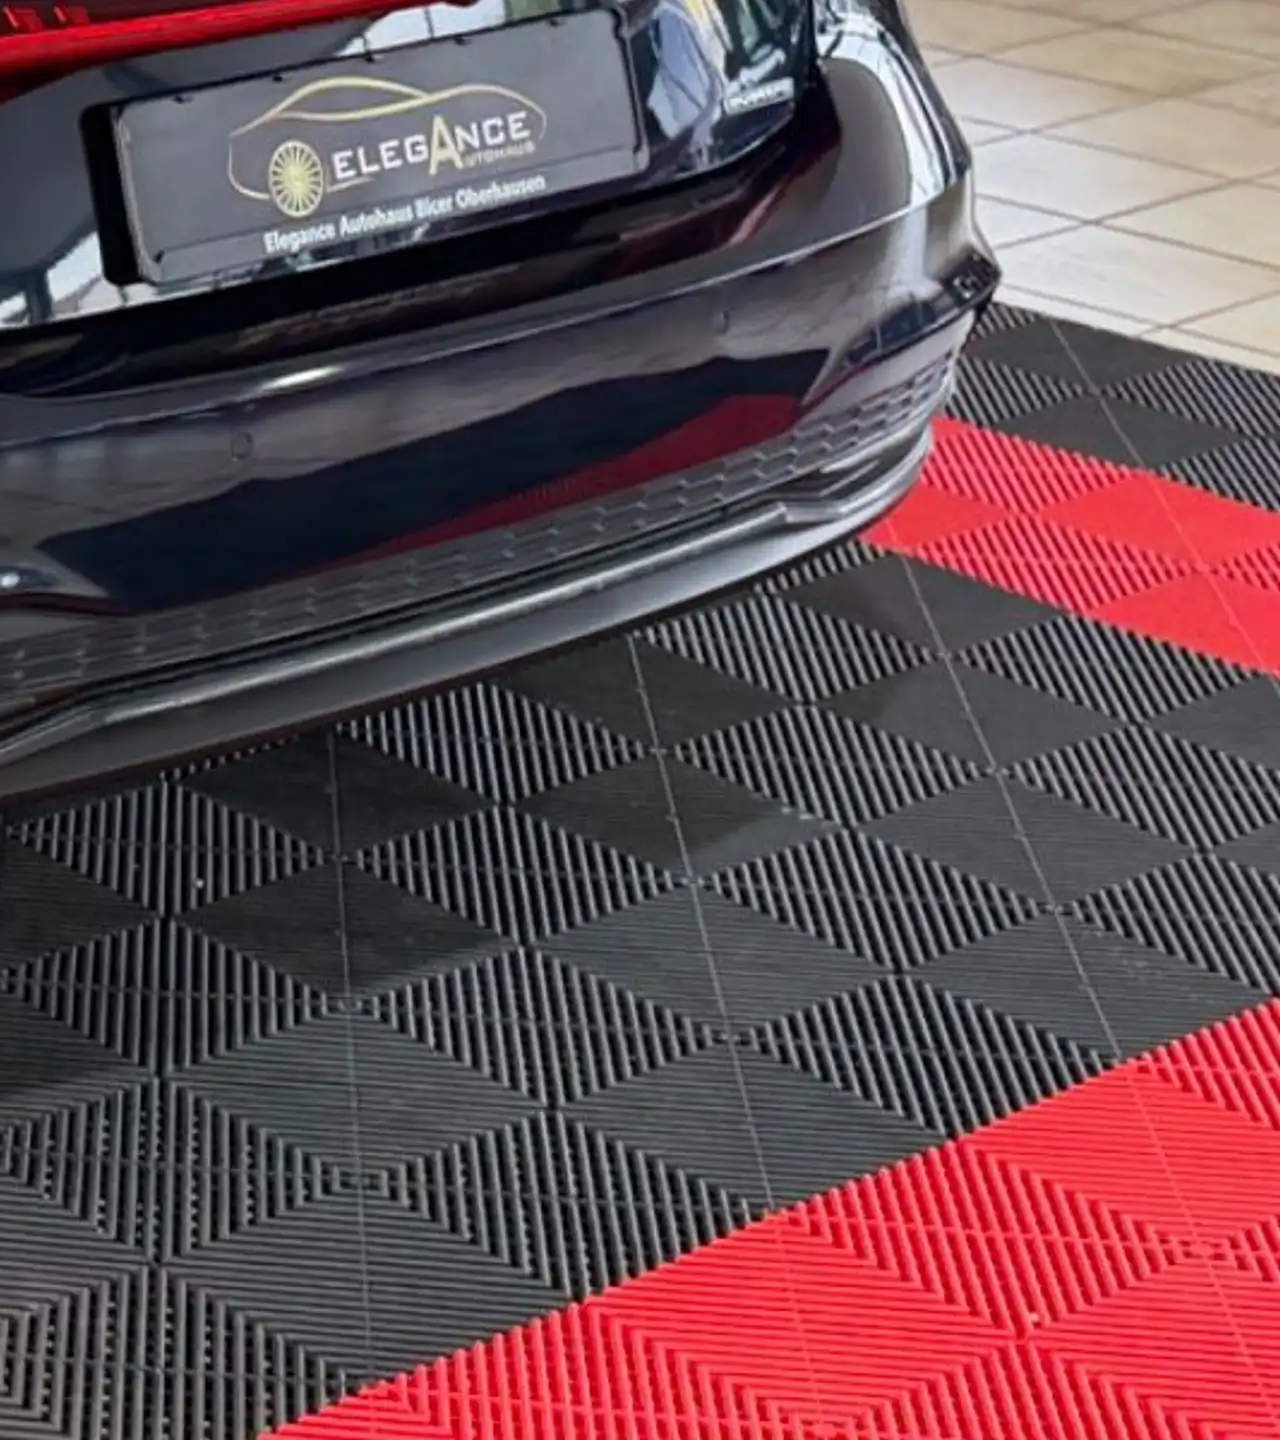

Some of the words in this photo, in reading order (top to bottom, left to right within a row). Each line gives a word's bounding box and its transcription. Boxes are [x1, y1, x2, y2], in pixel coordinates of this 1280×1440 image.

[332, 111, 532, 180] ELEGANCE
[264, 223, 337, 253] Elegance
[339, 206, 415, 237] Autohaus
[455, 173, 547, 210] Oberhausen
